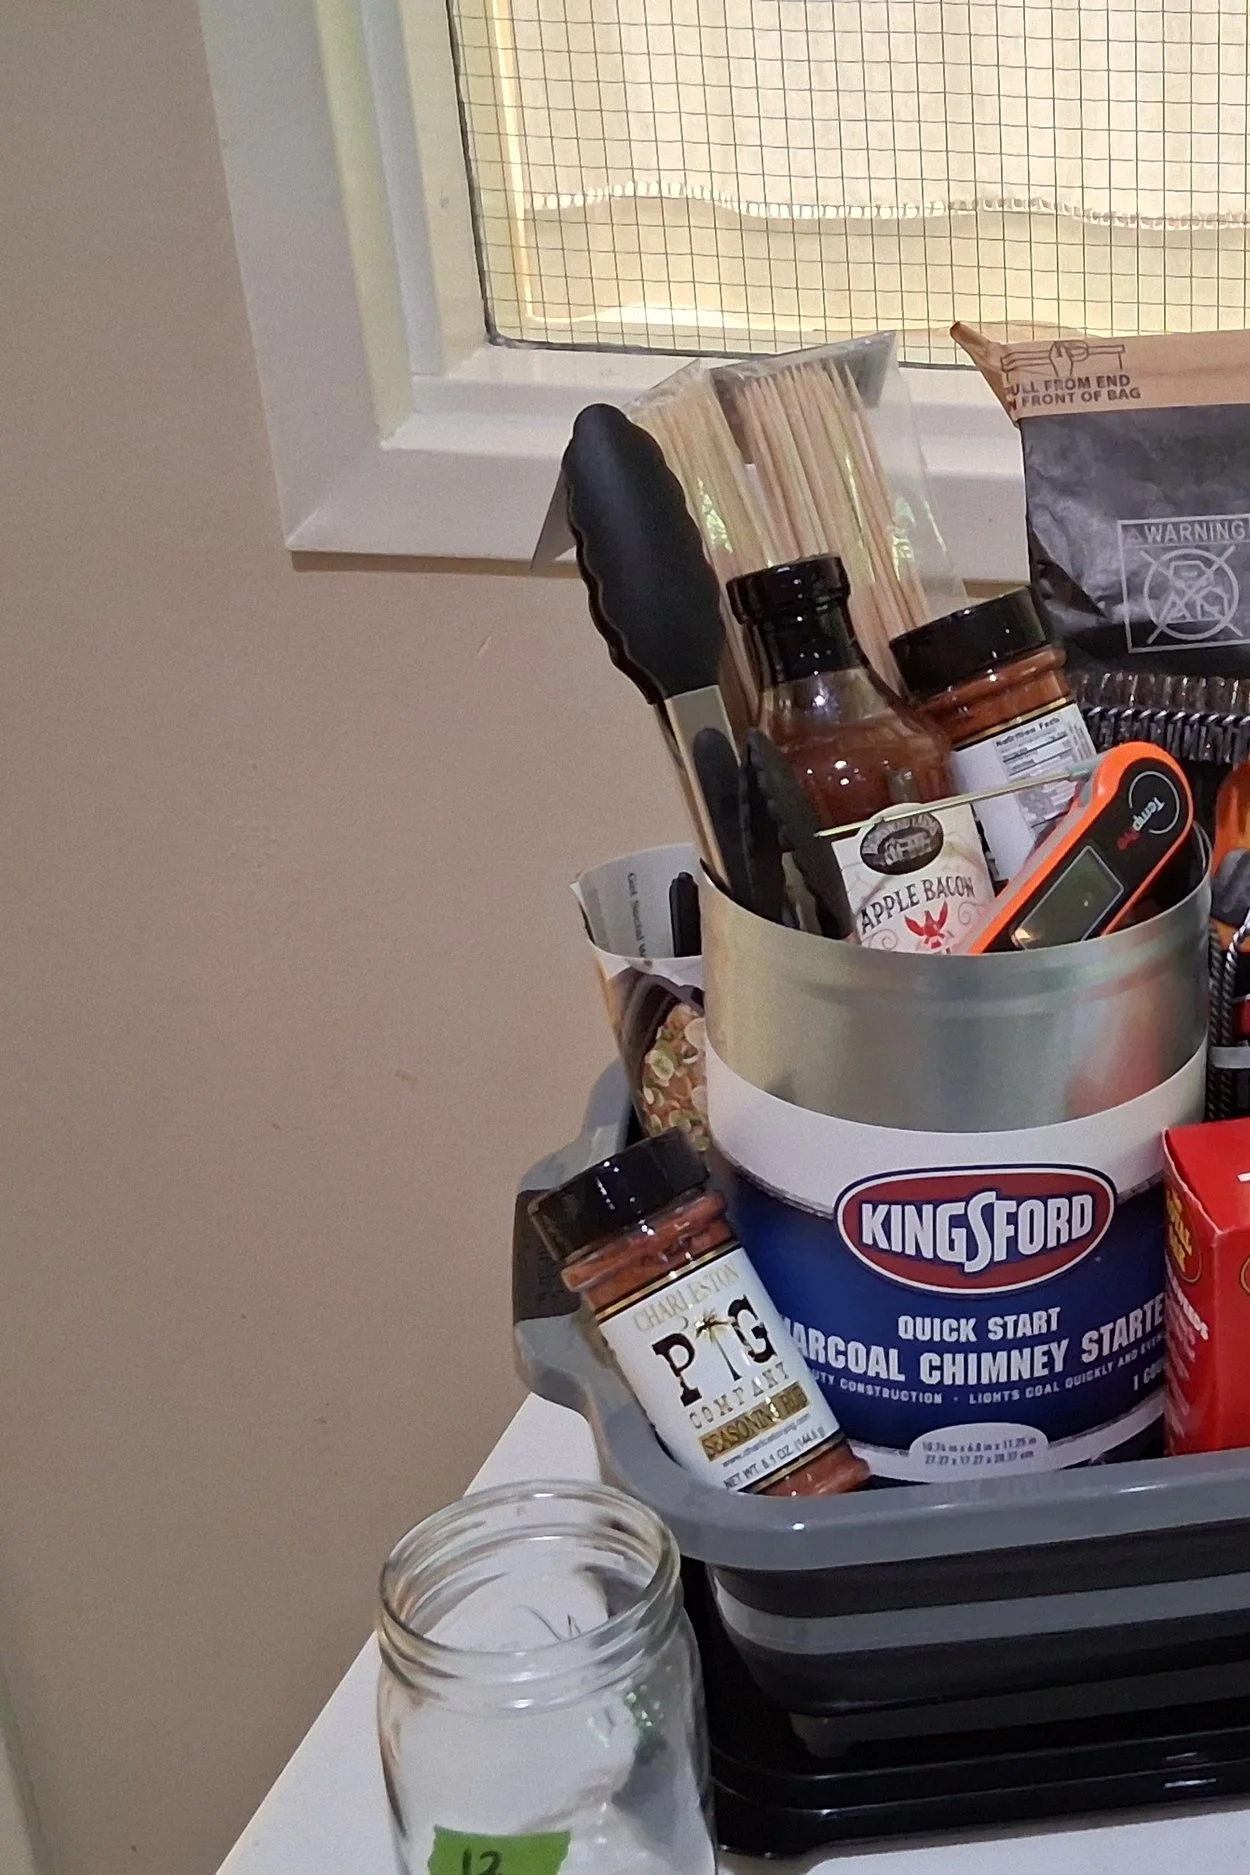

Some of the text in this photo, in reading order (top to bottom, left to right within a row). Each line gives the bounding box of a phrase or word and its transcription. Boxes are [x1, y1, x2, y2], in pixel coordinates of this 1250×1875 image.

[1021, 392, 1075, 407] FRONT
[1081, 391, 1103, 403] OF
[1107, 388, 1142, 401] BAG
[1045, 376, 1091, 392] FROM
[1096, 374, 1131, 388] END
[1144, 520, 1245, 543] WARNING
[1131, 796, 1165, 832] Temp
[861, 875, 976, 934] APPLE BACON
[860, 1190, 1095, 1273] KINGSFORD
[632, 1262, 742, 1333] CHARLESTON
[897, 1306, 1062, 1343] QUICK START
[780, 1313, 906, 1382] ARCOAL
[919, 1337, 1070, 1386] CHIMNEY
[688, 1360, 791, 1430] COMPANY
[839, 1377, 943, 1405] CONSTRUCTION
[968, 1388, 1021, 1405] LIGHTS
[1024, 1380, 1061, 1398] COAL
[1063, 1360, 1114, 1390] QUICKLY
[1116, 1347, 1139, 1368] AND
[723, 1471, 742, 1489] NET
